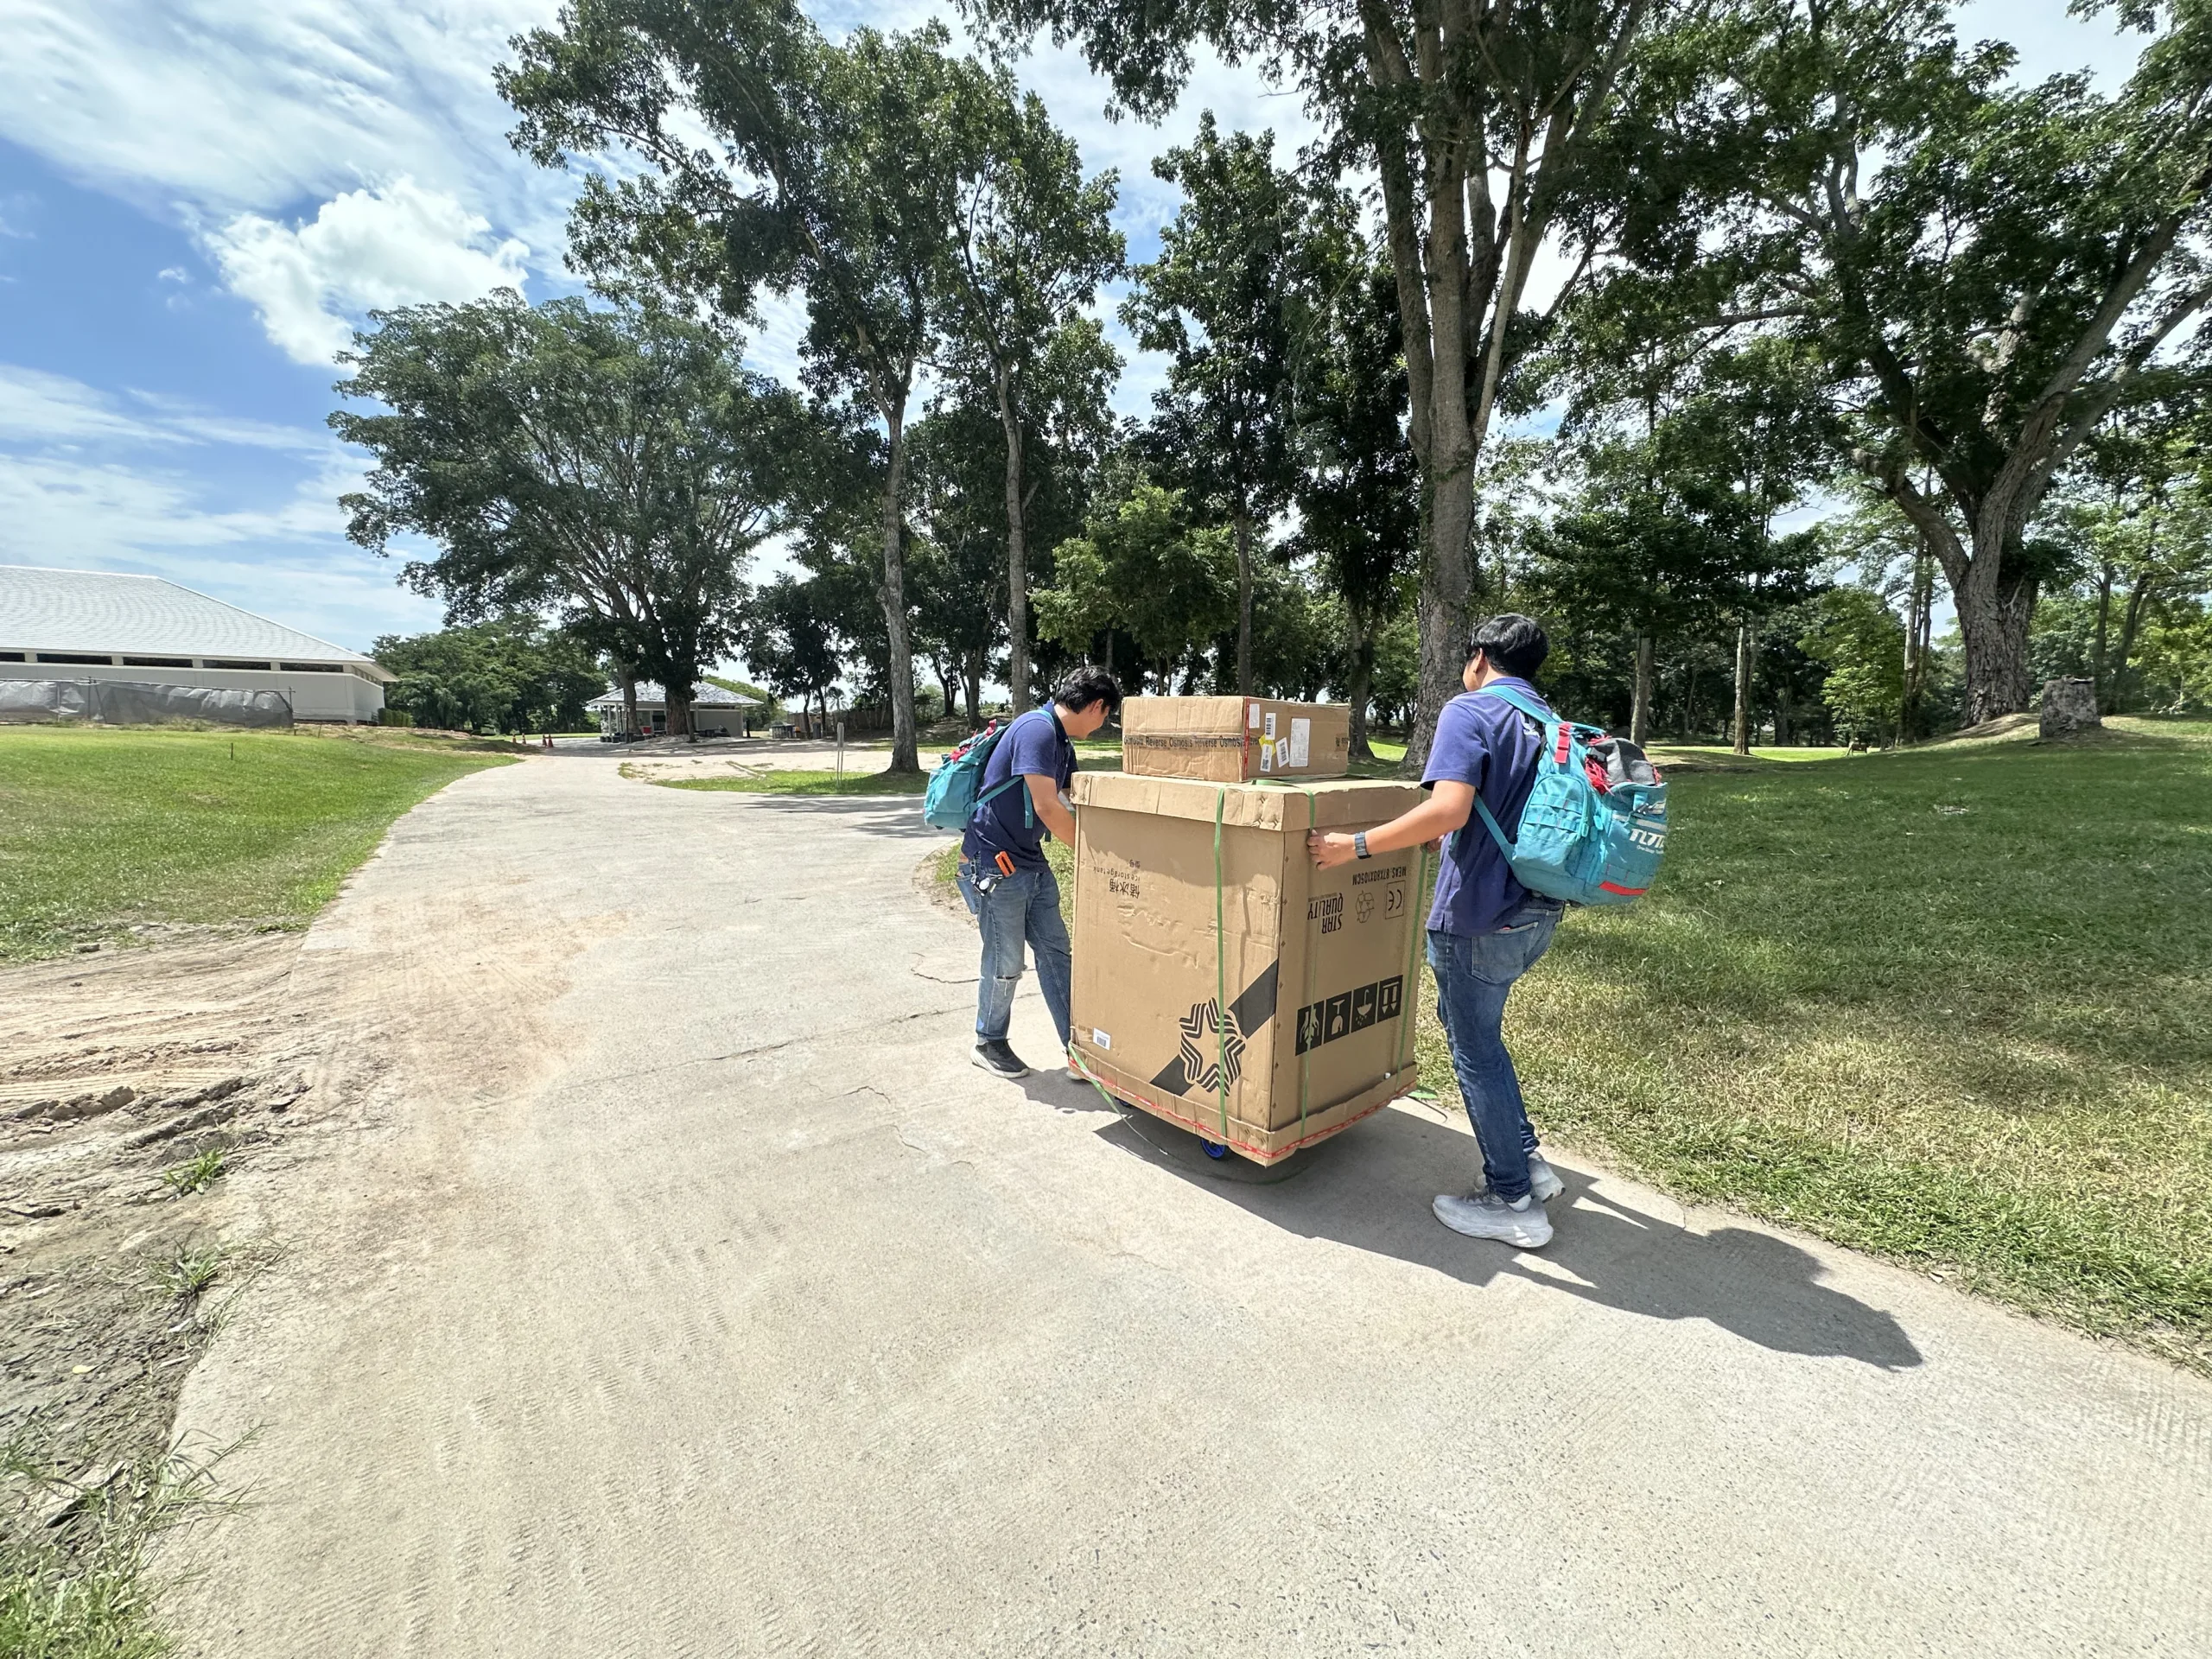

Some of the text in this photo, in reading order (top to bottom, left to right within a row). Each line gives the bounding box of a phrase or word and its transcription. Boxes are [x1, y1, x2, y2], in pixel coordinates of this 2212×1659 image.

[1145, 736, 1167, 747] Reverse
[1169, 737, 1192, 747] Osmosis
[1109, 879, 1140, 899] 储冰桶
[1307, 893, 1344, 920] QUALITY
[1321, 913, 1343, 934] STAR
